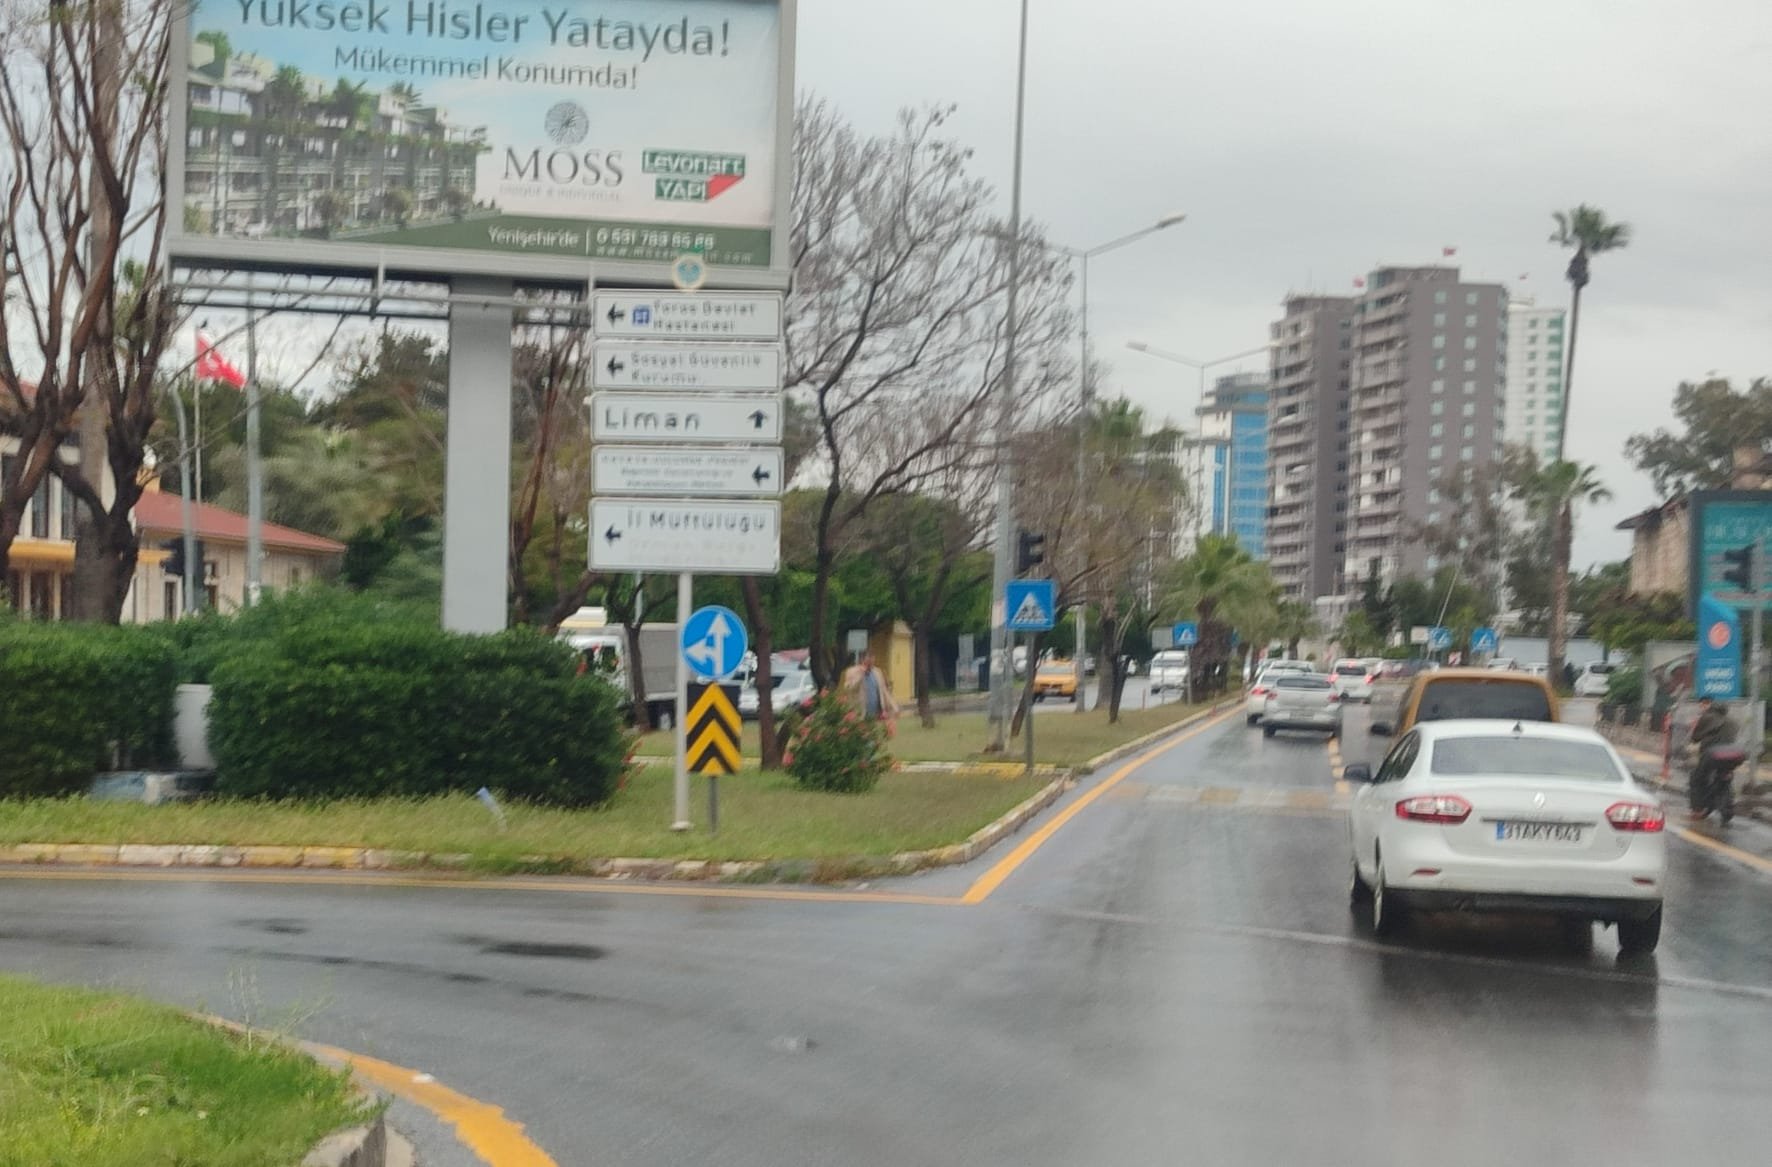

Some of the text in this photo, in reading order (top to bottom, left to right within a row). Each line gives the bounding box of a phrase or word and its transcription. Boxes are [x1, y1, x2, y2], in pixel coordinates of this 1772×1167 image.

[407, 0, 528, 43] Hisler
[542, 8, 729, 62] Yatayda!
[335, 46, 637, 90] Mükemmel Konumda!
[504, 146, 623, 187] MOSS
[645, 151, 742, 175] Levonart
[605, 407, 699, 430] Liman
